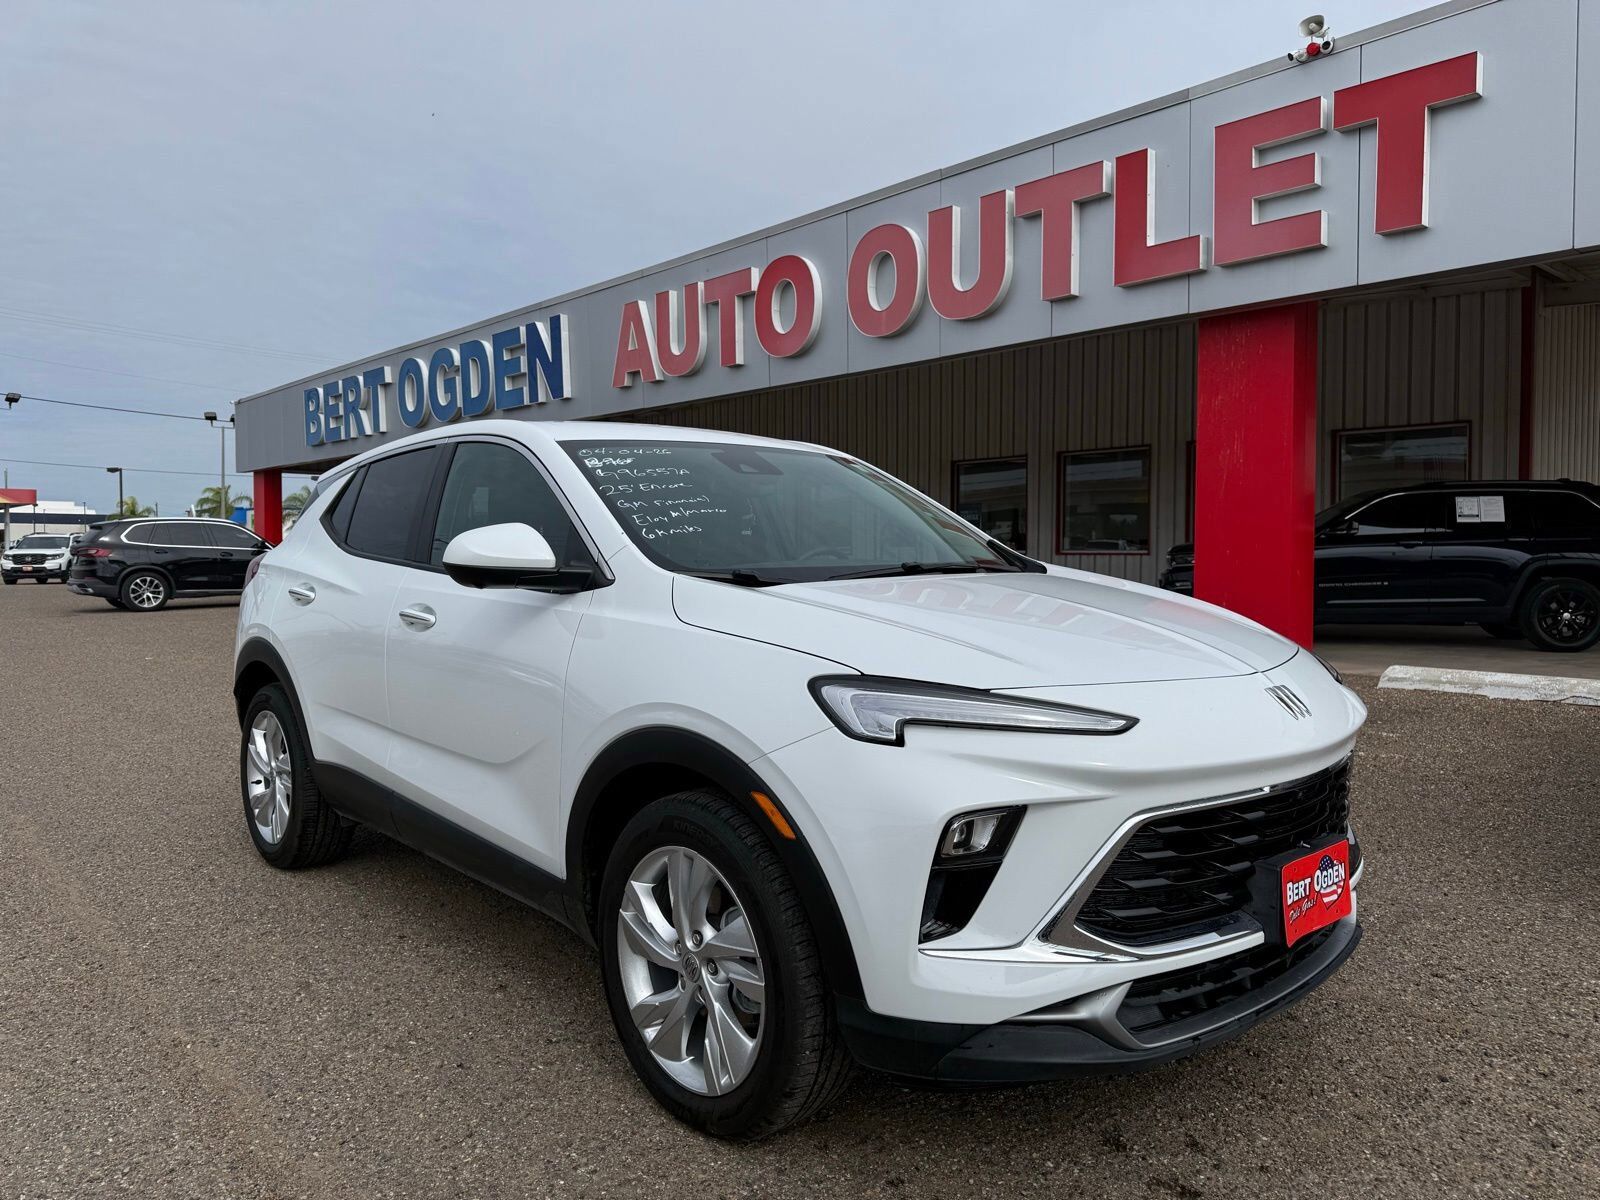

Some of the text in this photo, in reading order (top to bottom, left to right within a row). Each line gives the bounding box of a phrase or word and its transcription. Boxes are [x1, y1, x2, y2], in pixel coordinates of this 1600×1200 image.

[612, 51, 1482, 389] AUTO OUTLET
[304, 313, 572, 448] BERT OGDEN
[1286, 863, 1345, 906] BERT OGDEN
